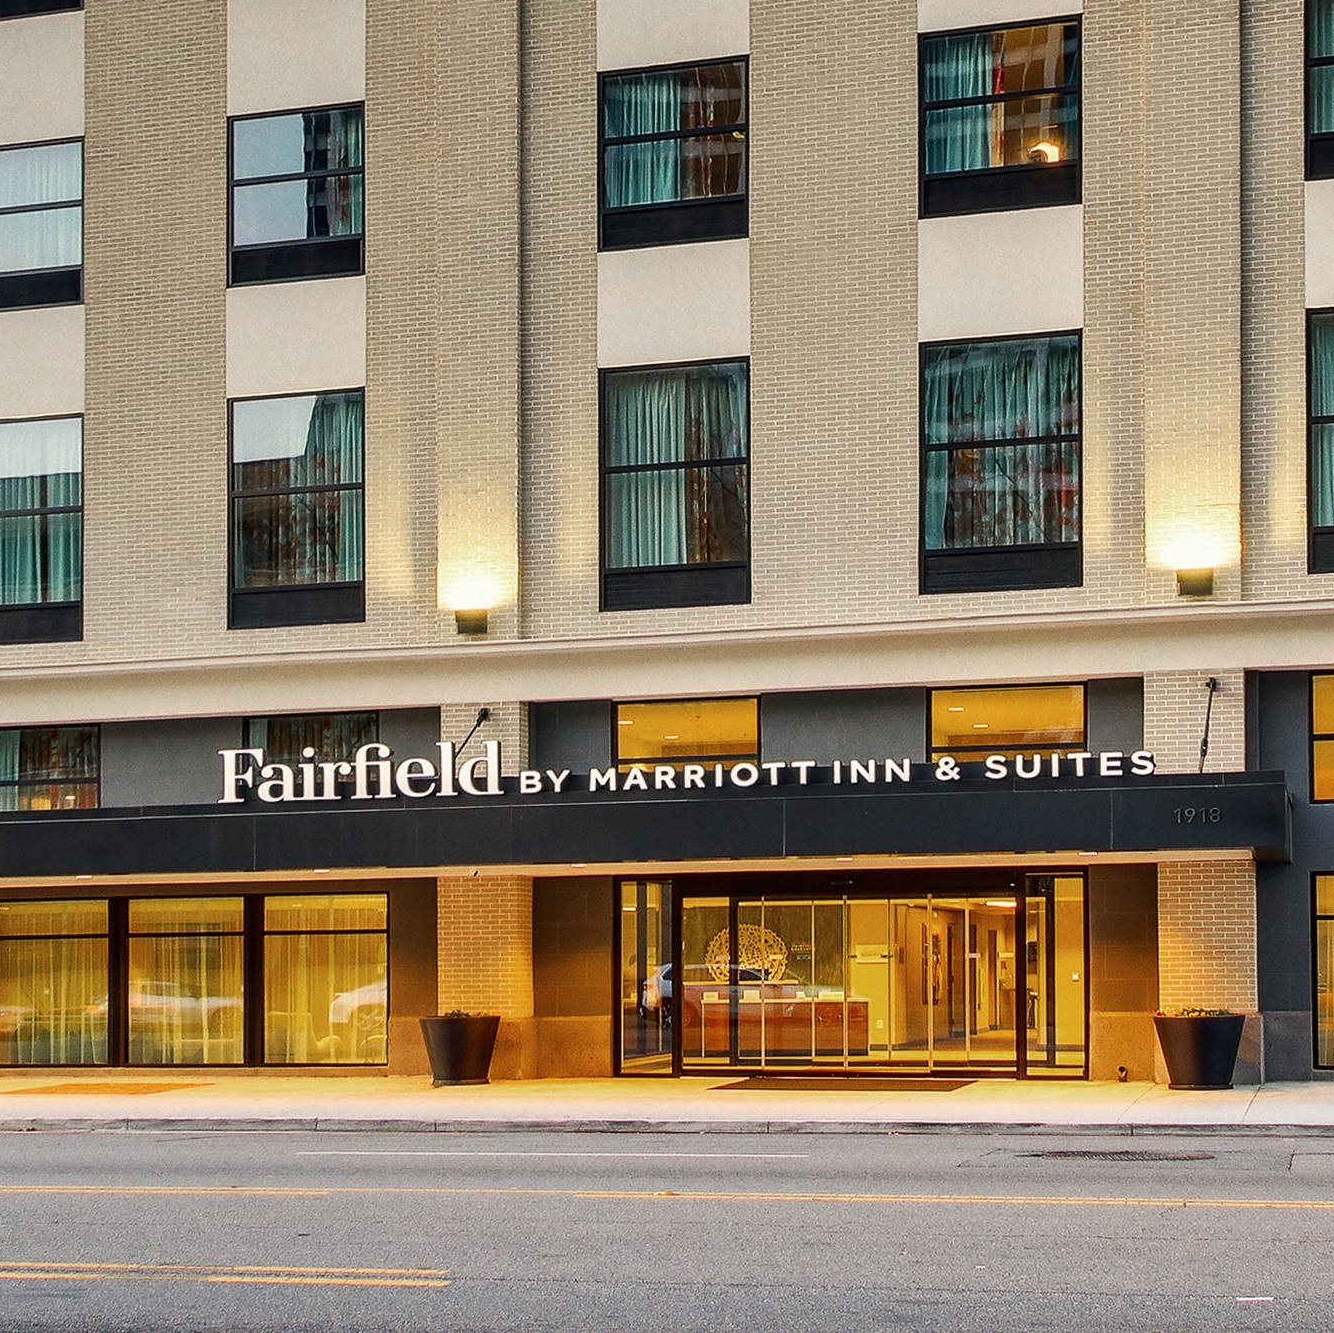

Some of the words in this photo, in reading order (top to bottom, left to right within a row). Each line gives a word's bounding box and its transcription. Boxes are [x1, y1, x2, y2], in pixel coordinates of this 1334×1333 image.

[217, 740, 505, 804] Fairfield
[519, 769, 571, 795] BY
[588, 760, 817, 792] MARRIOTT
[832, 759, 912, 785] INN
[935, 756, 961, 780] &
[984, 750, 1157, 780] SUITES
[1173, 807, 1221, 824] 1918
